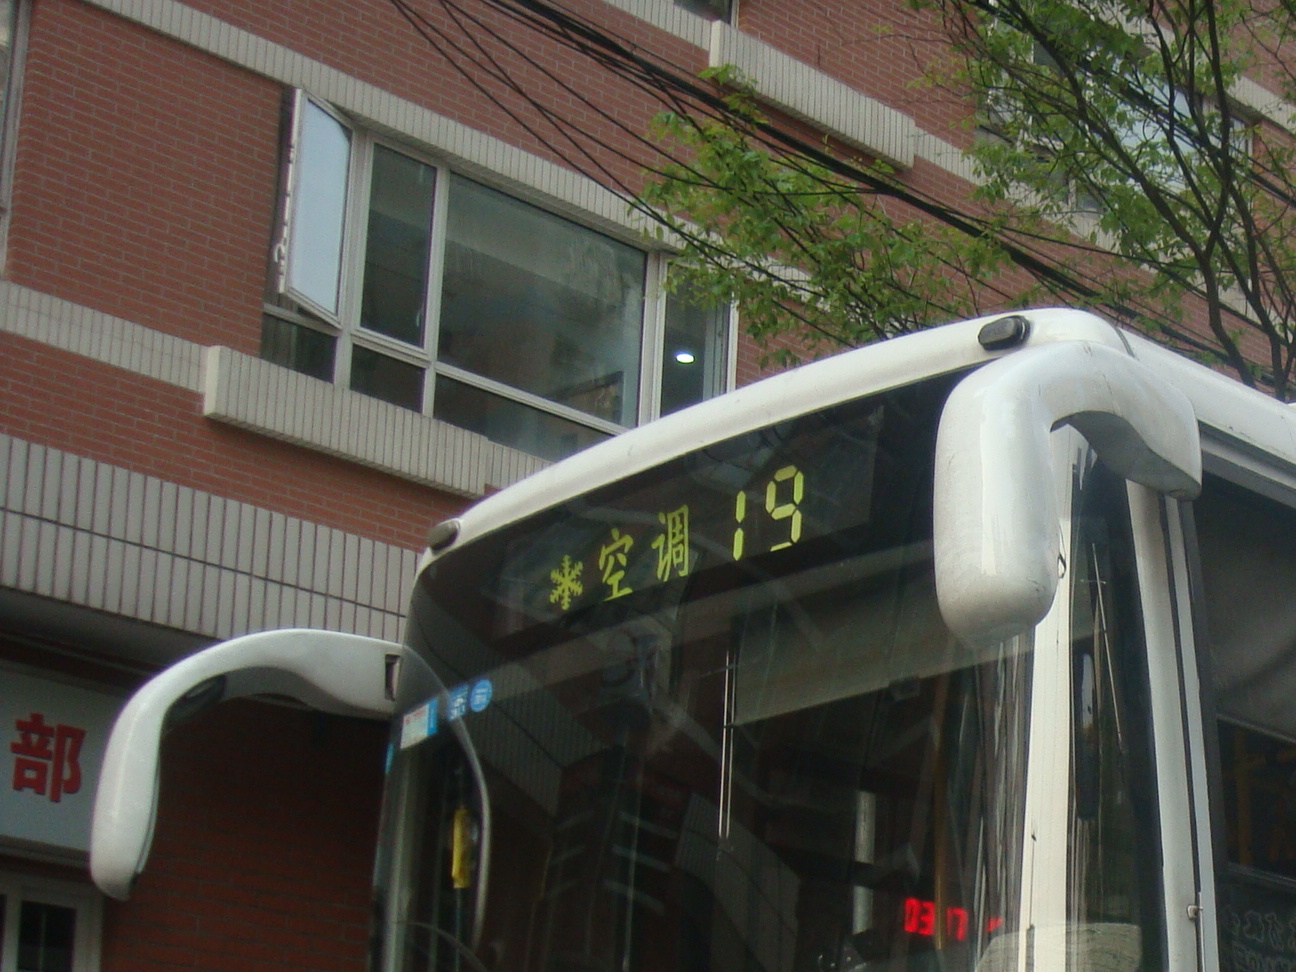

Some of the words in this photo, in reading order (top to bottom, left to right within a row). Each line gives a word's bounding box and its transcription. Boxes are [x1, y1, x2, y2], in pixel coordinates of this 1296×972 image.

[599, 504, 690, 602] 空调
[732, 464, 804, 562] 19
[10, 712, 87, 803] 部
